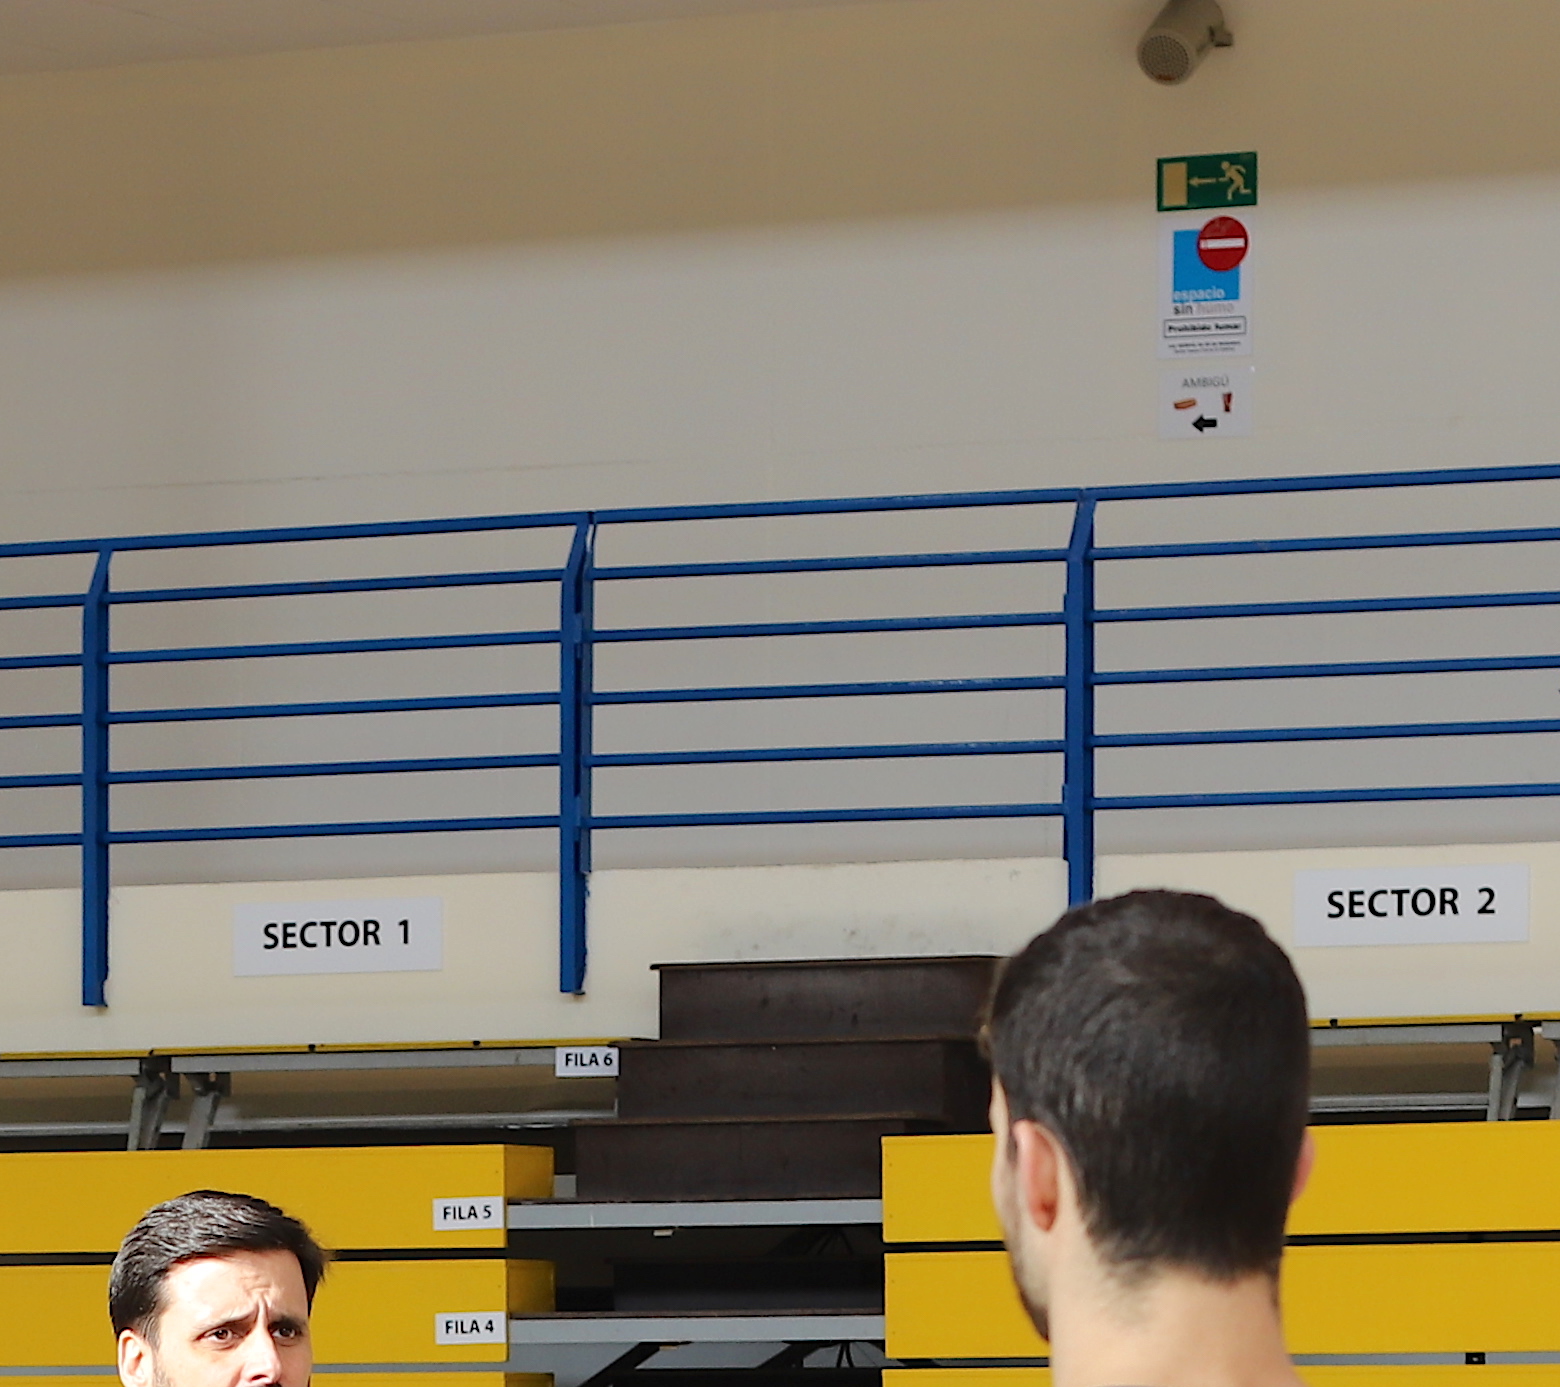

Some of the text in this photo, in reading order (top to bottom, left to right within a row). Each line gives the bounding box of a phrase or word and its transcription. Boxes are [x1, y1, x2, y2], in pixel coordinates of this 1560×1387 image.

[1173, 286, 1226, 302] espacio
[1173, 304, 1194, 315] sin
[1327, 887, 1495, 918] SECTOR 2
[263, 919, 410, 950] SECTOR 1
[564, 1052, 614, 1068] FILA 6
[443, 1204, 492, 1220] FILA 5
[445, 1319, 494, 1334] FILA 4
